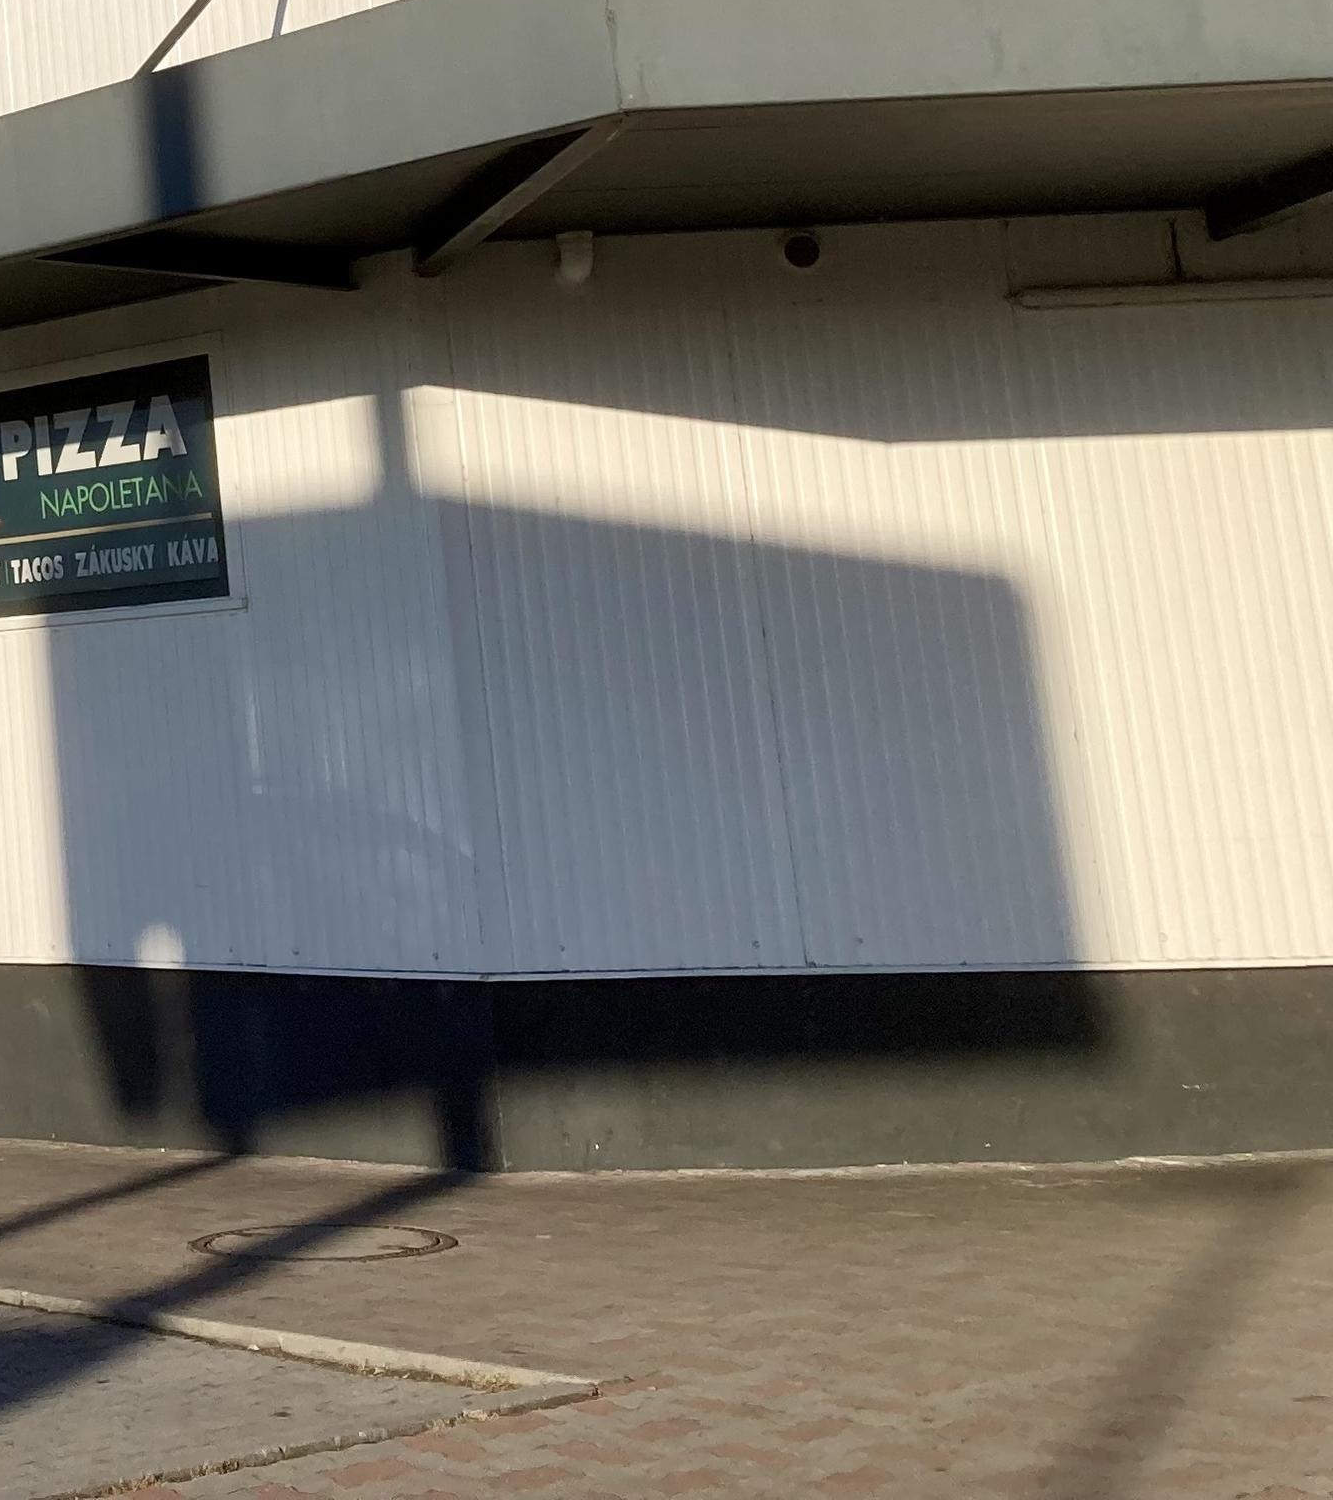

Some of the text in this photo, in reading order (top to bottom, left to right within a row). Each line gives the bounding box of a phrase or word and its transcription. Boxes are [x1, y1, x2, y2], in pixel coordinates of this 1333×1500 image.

[0, 394, 187, 481] PIZZA
[40, 469, 203, 519] NAPOLETANA
[10, 555, 64, 585] TACOS
[75, 544, 155, 577] ZÁKUSKY
[168, 534, 219, 567] KÁVA
